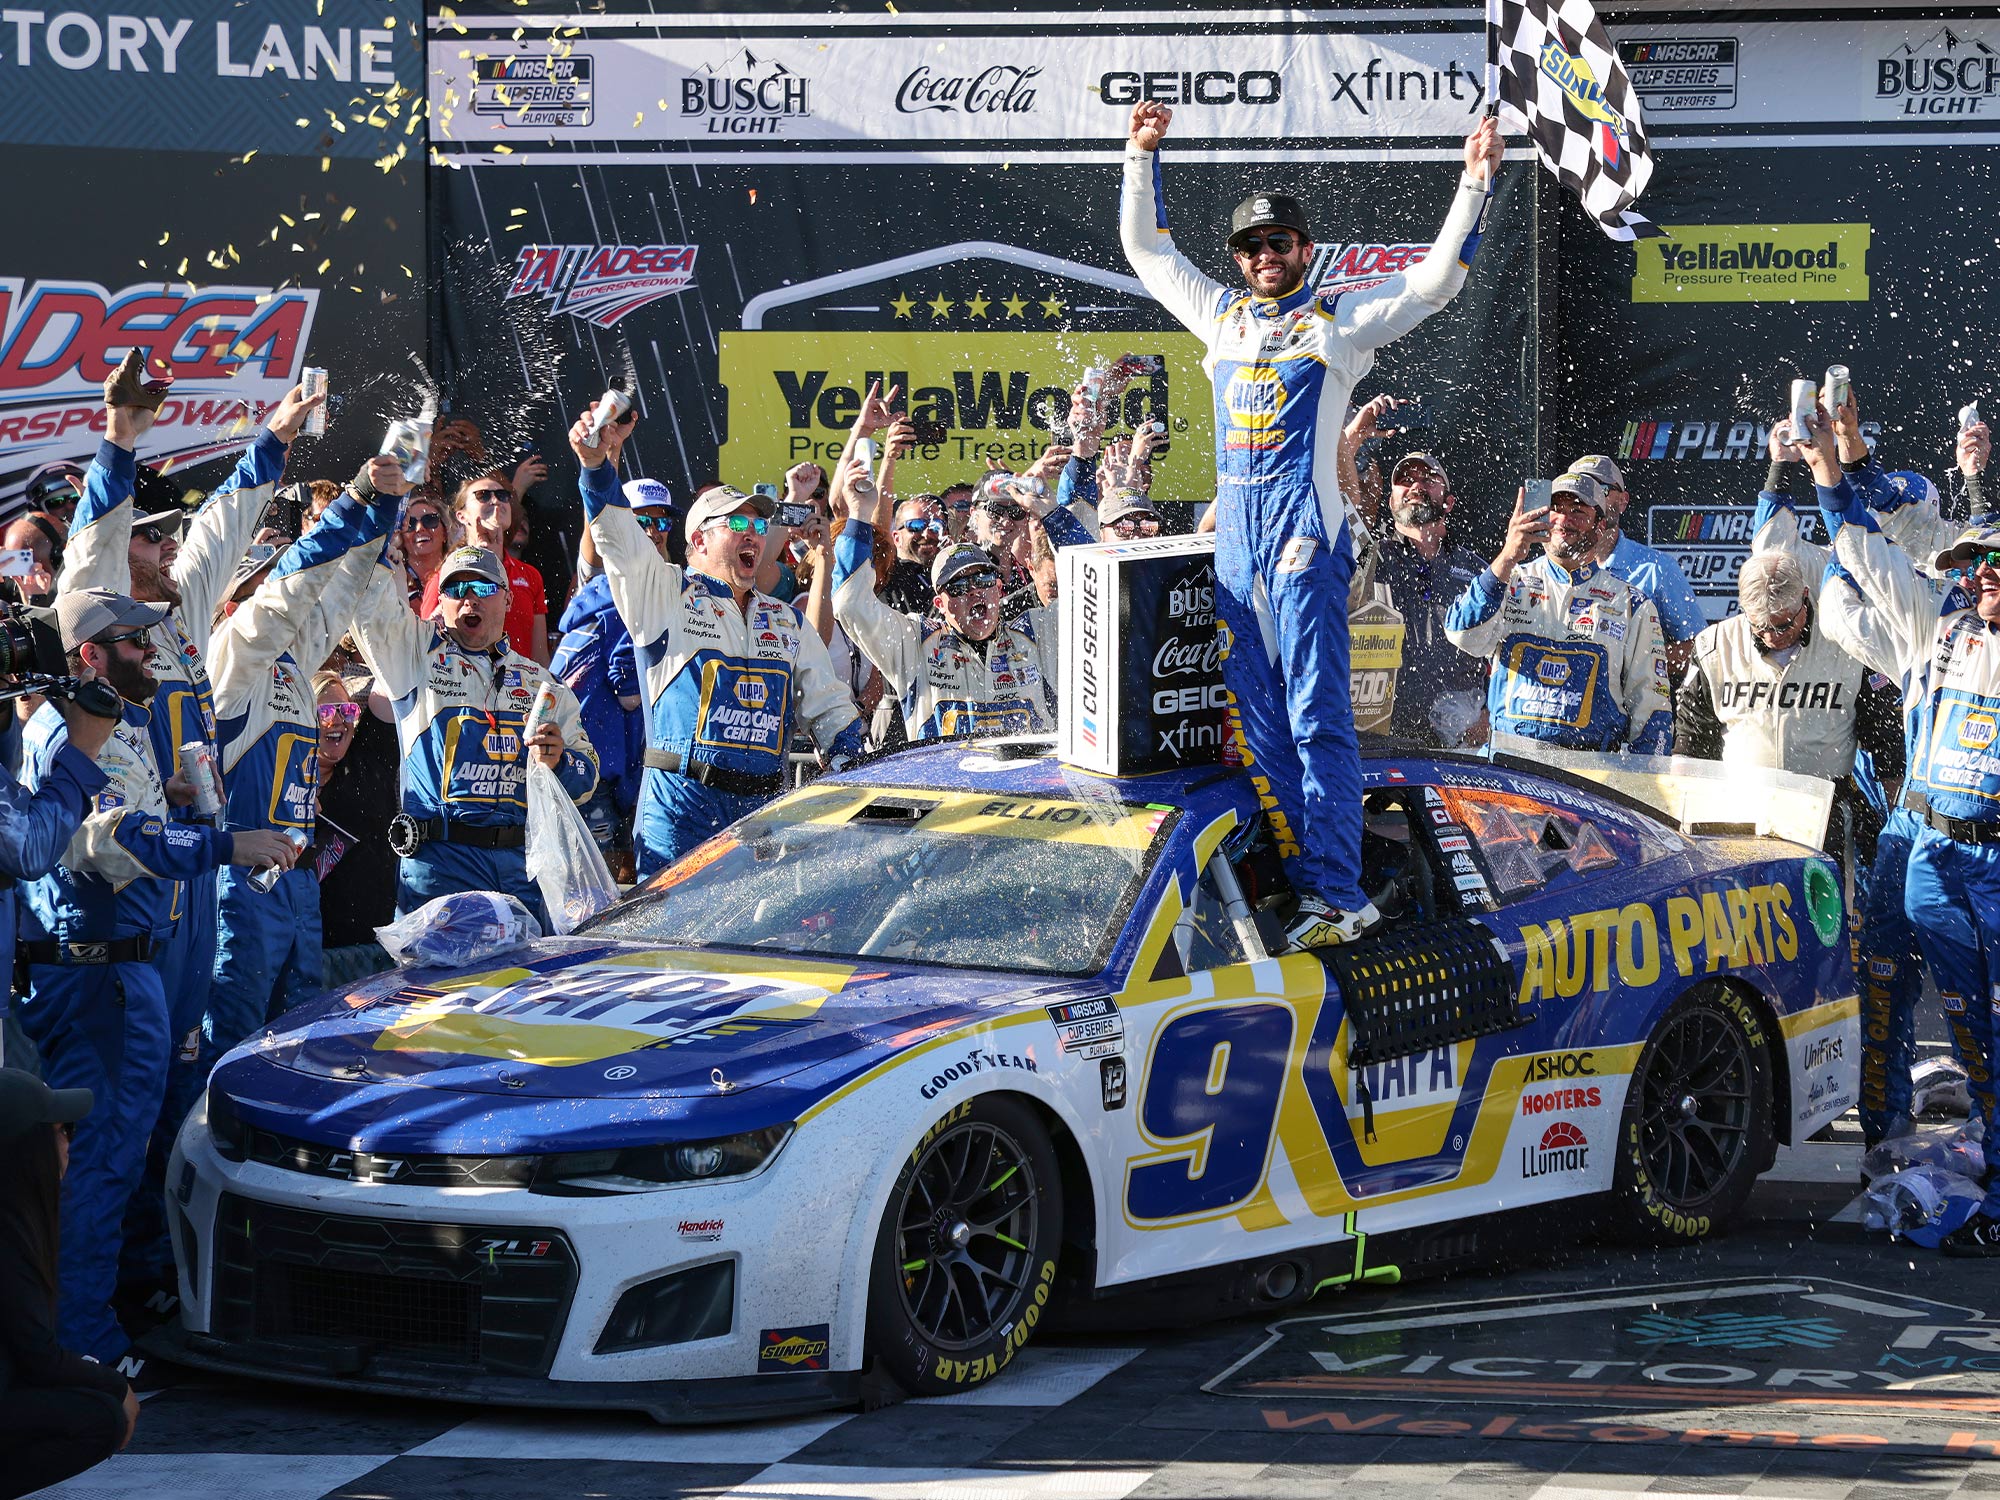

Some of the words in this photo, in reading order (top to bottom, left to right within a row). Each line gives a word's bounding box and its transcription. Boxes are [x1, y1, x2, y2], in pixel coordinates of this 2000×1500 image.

[216, 20, 396, 85] LANE
[1654, 44, 1720, 62] NASCAR
[512, 61, 575, 79] NASCAR
[1632, 69, 1663, 86] CUP
[1664, 68, 1719, 85] SERIES
[524, 85, 577, 102] SERIES
[680, 77, 811, 117] BUSCH
[895, 65, 1045, 113] Coca-Cola
[1100, 71, 1282, 106] GEICO
[1330, 58, 1486, 115] xfinity
[1662, 95, 1717, 107] PLAYOFFS
[1904, 97, 1983, 114] LIGHT
[521, 112, 575, 124] PLAYOFFS
[707, 116, 782, 134] LIGHT
[1658, 241, 1838, 270] YellaWood
[507, 245, 698, 302] TALLADEGA
[1663, 271, 1733, 285] Pressure
[1736, 270, 1797, 284] Treated
[1802, 270, 1837, 283] Pine
[569, 276, 689, 300] SUPERSPEEDWAY
[0, 290, 309, 389] DEGA
[1231, 382, 1277, 412] NAPA
[1275, 536, 1320, 574] 9
[1082, 562, 1098, 660] SERIES
[1168, 586, 1216, 619] BUS
[682, 627, 721, 640] GOODYEAR
[687, 616, 716, 630] UniFirst
[1184, 615, 1217, 628] LIGH
[757, 650, 782, 659] ASHOC
[1540, 662, 1566, 678] NAPA
[738, 681, 765, 701] NAPA
[1083, 662, 1098, 716] CUP
[1152, 684, 1229, 715] GEIC
[1350, 671, 1389, 706] 500
[1721, 681, 1844, 709] OFFICIAL
[723, 726, 769, 744] CENTER
[1158, 719, 1222, 759] xfini
[1963, 721, 1992, 741] NAPA
[470, 781, 517, 796] CENTER
[1510, 778, 1560, 804] Kelley
[1559, 791, 1595, 814] Blue
[1595, 804, 1634, 827] Book
[167, 837, 194, 848] CENTER
[1518, 902, 1660, 1005] AUTO
[1667, 881, 1799, 977] PARTS
[1871, 963, 1892, 977] NAPA
[1071, 1000, 1107, 1019] NASCAR
[1719, 988, 1765, 1049] EAGLE
[1067, 1024, 1086, 1040] CUP
[1086, 1019, 1114, 1037] SERIES
[1522, 1051, 1598, 1083] ASHOC
[1804, 1036, 1843, 1071] UniFirst
[1104, 1064, 1125, 1105] 12
[1123, 998, 1297, 1231] 9
[1521, 1087, 1602, 1116] HOOTERS
[913, 1097, 974, 1167] EAGLE
[676, 1219, 725, 1235] Hendrick
[475, 1239, 552, 1257] ZL1
[763, 1341, 825, 1359] SUNOCO
[1309, 1350, 1964, 1391] VICTORY
[1260, 1409, 1890, 1449] Welcome
